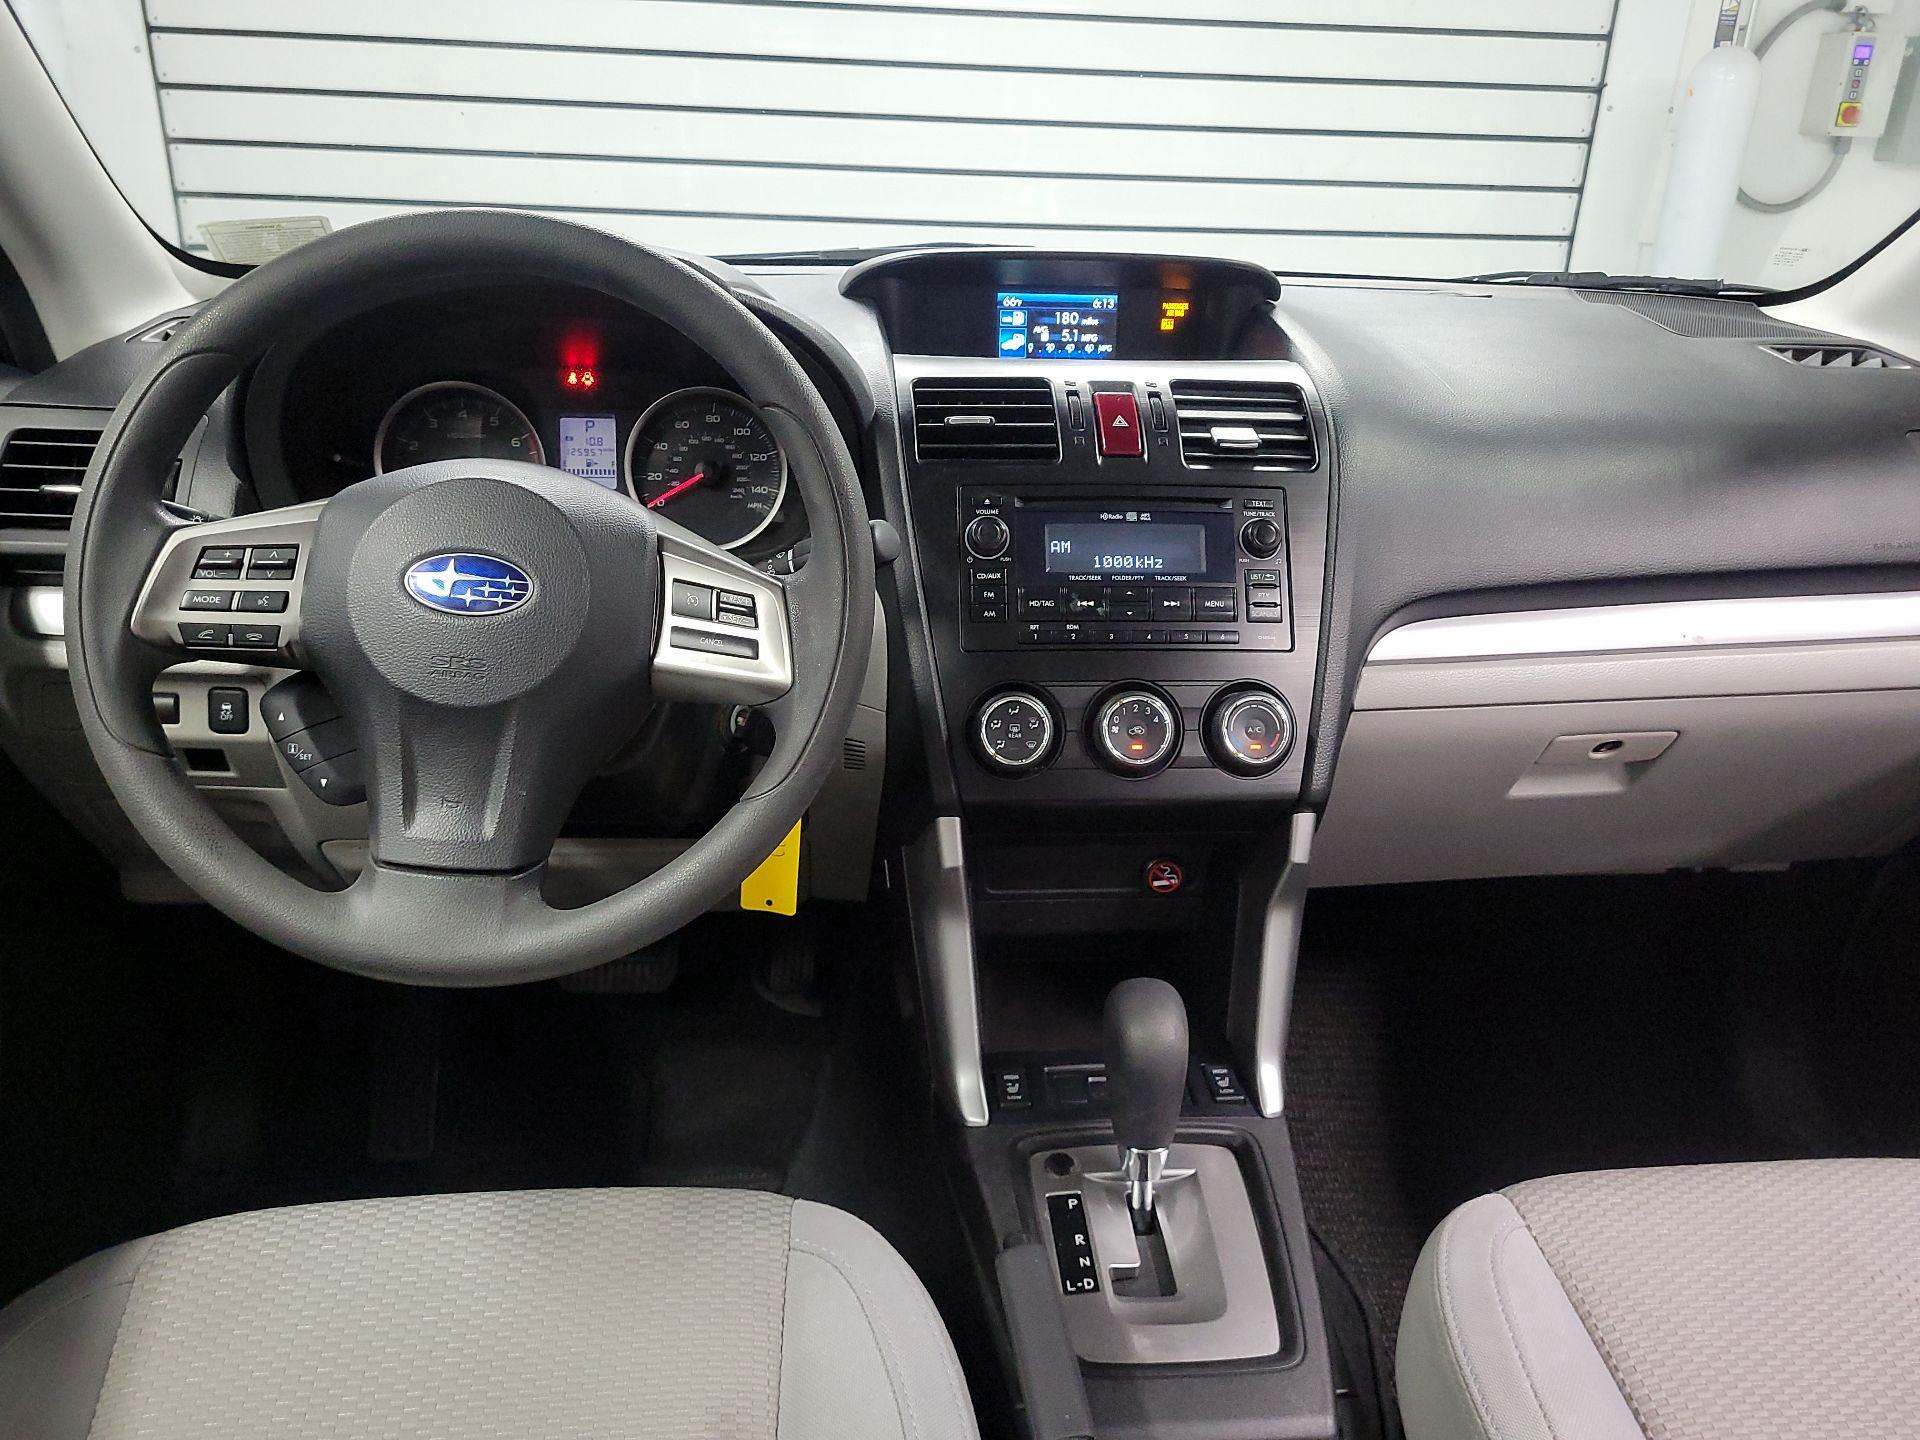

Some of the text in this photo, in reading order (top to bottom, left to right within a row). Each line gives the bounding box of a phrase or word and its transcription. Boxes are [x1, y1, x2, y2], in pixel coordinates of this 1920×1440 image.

[1092, 298, 1114, 309] 6:13
[1055, 312, 1079, 324] 180
[1062, 329, 1078, 342] 5.1
[490, 416, 499, 426] 5
[586, 420, 595, 432] P
[733, 428, 750, 436] 100
[510, 438, 520, 447] 6
[751, 486, 768, 494] 140
[1050, 541, 1071, 553] AM
[1094, 556, 1163, 568] 1000kHz
[192, 596, 221, 604] MODE
[700, 638, 724, 646] CANCEL
[1133, 704, 1138, 712] 2
[1068, 1199, 1078, 1209] P
[1074, 1235, 1086, 1246] R
[1079, 1257, 1091, 1267] N
[1067, 1278, 1095, 1292] L-D
